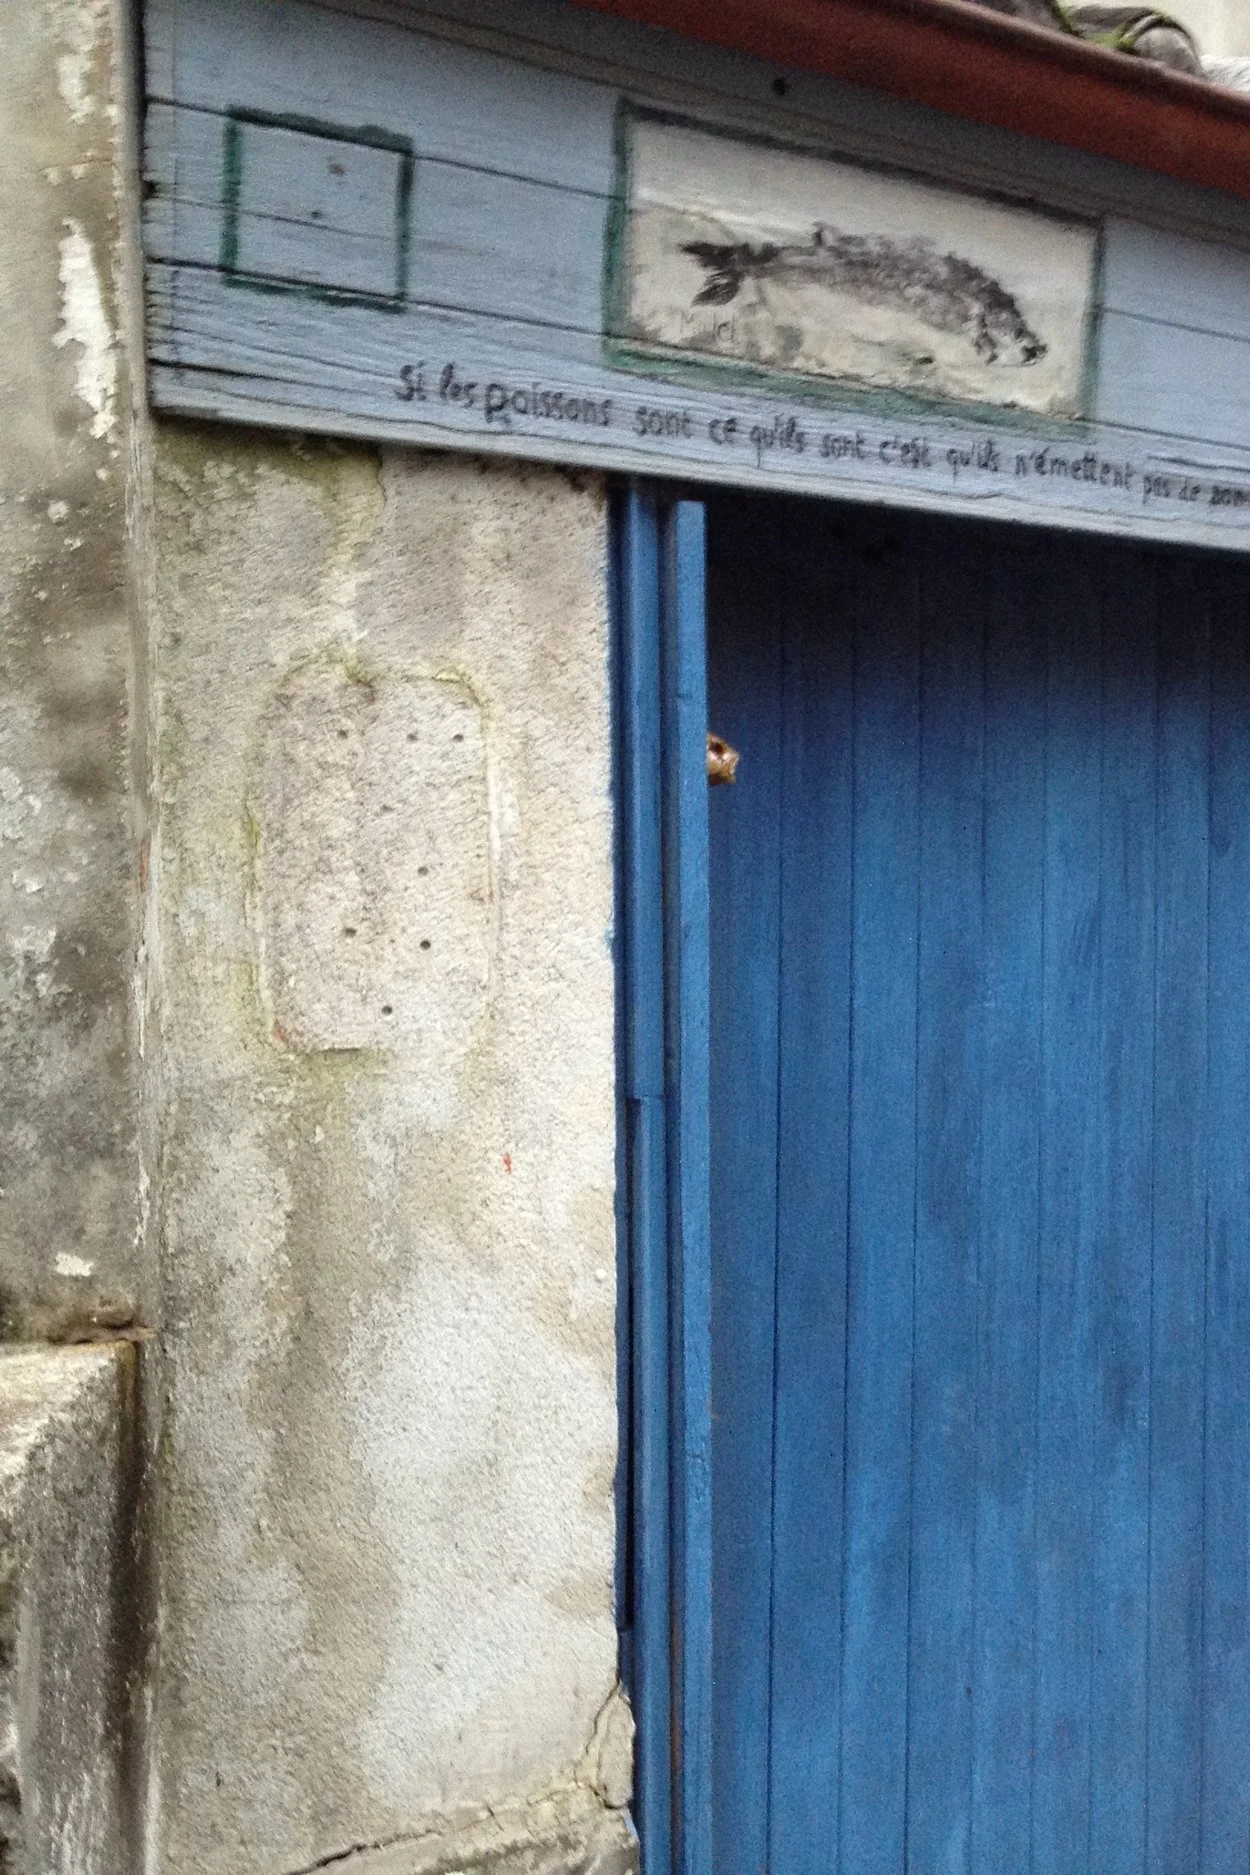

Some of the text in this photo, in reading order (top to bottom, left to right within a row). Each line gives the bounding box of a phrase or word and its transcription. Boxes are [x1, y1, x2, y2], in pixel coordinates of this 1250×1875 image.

[394, 361, 426, 401] Si
[439, 361, 478, 408] les
[632, 406, 692, 437] sont
[708, 418, 738, 446] ce
[750, 412, 808, 468] qu'ils
[820, 430, 866, 460] sont
[879, 435, 932, 469] c'est
[946, 438, 1000, 483] qu'ils
[1014, 447, 1136, 490] n'émettent
